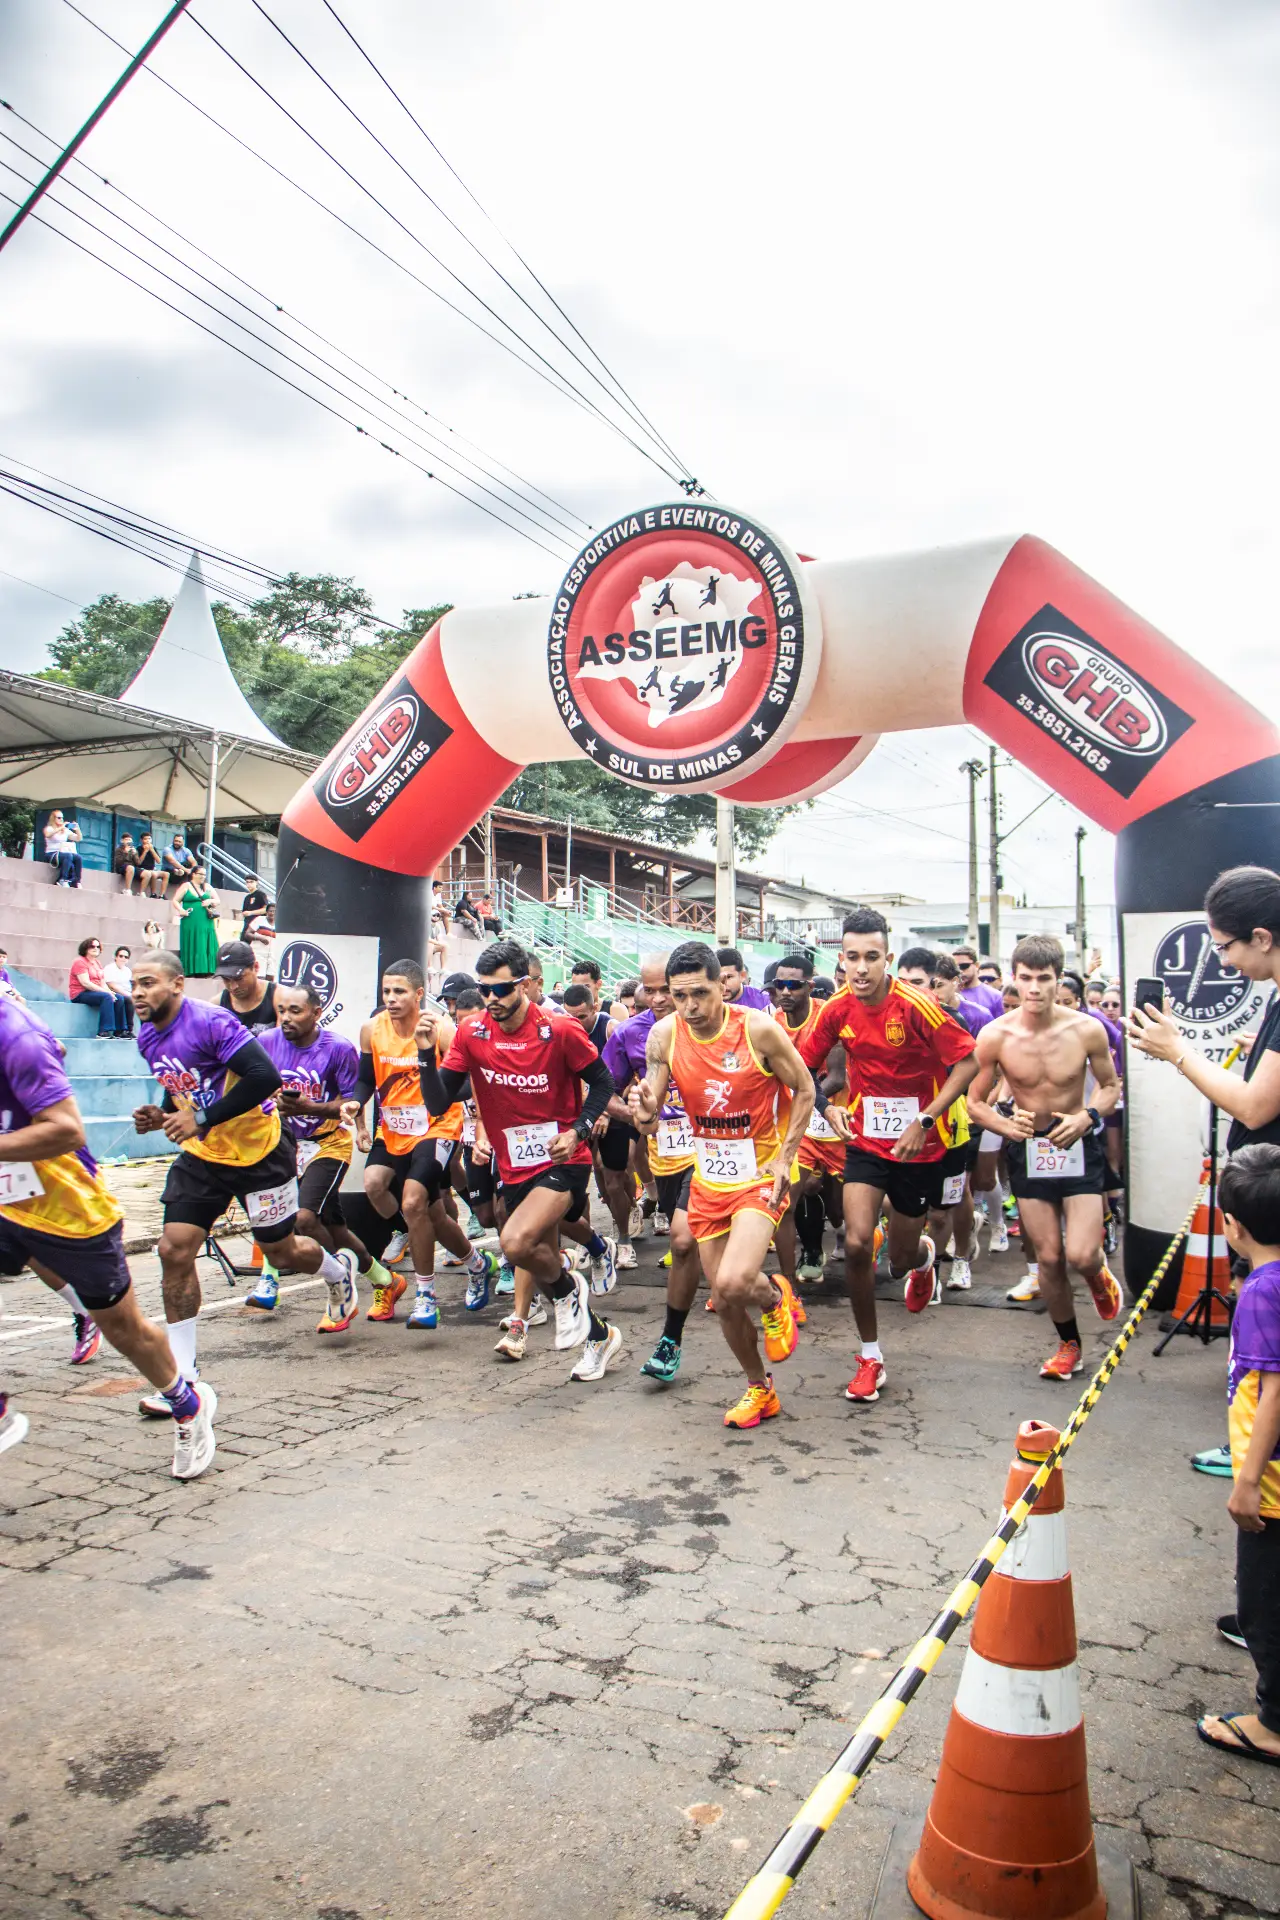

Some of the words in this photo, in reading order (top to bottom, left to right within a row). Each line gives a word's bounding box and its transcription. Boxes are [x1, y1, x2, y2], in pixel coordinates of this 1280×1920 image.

[644, 511, 656, 530] E
[660, 508, 741, 538] EVENTOS
[564, 517, 641, 595] ESPORTIVA
[739, 529, 766, 557] DE
[758, 557, 795, 619] MINAS
[578, 615, 767, 668] ASSEEMG
[550, 599, 583, 731] ASSOCIAÇÃO
[768, 625, 797, 706] GERAIS
[1086, 656, 1132, 695] GRUPO
[1033, 645, 1151, 746] GHB
[350, 722, 378, 757] GRUPO
[1016, 693, 1111, 772] 35.3851.2165
[335, 707, 412, 797] GHB
[608, 752, 643, 778] SUL
[648, 764, 674, 780] DE
[678, 744, 742, 780] MINAS
[366, 740, 431, 816] 35.3851.2165
[1216, 995, 1263, 1037] VAREJO
[494, 1073, 549, 1087] SICOOB
[518, 1085, 549, 1094] Copersul
[390, 1117, 414, 1130] 357
[872, 1116, 903, 1131] 172
[515, 1143, 546, 1160] 243
[705, 1158, 738, 1176] 223
[1036, 1155, 1067, 1171] 297
[258, 1201, 287, 1222] 295
